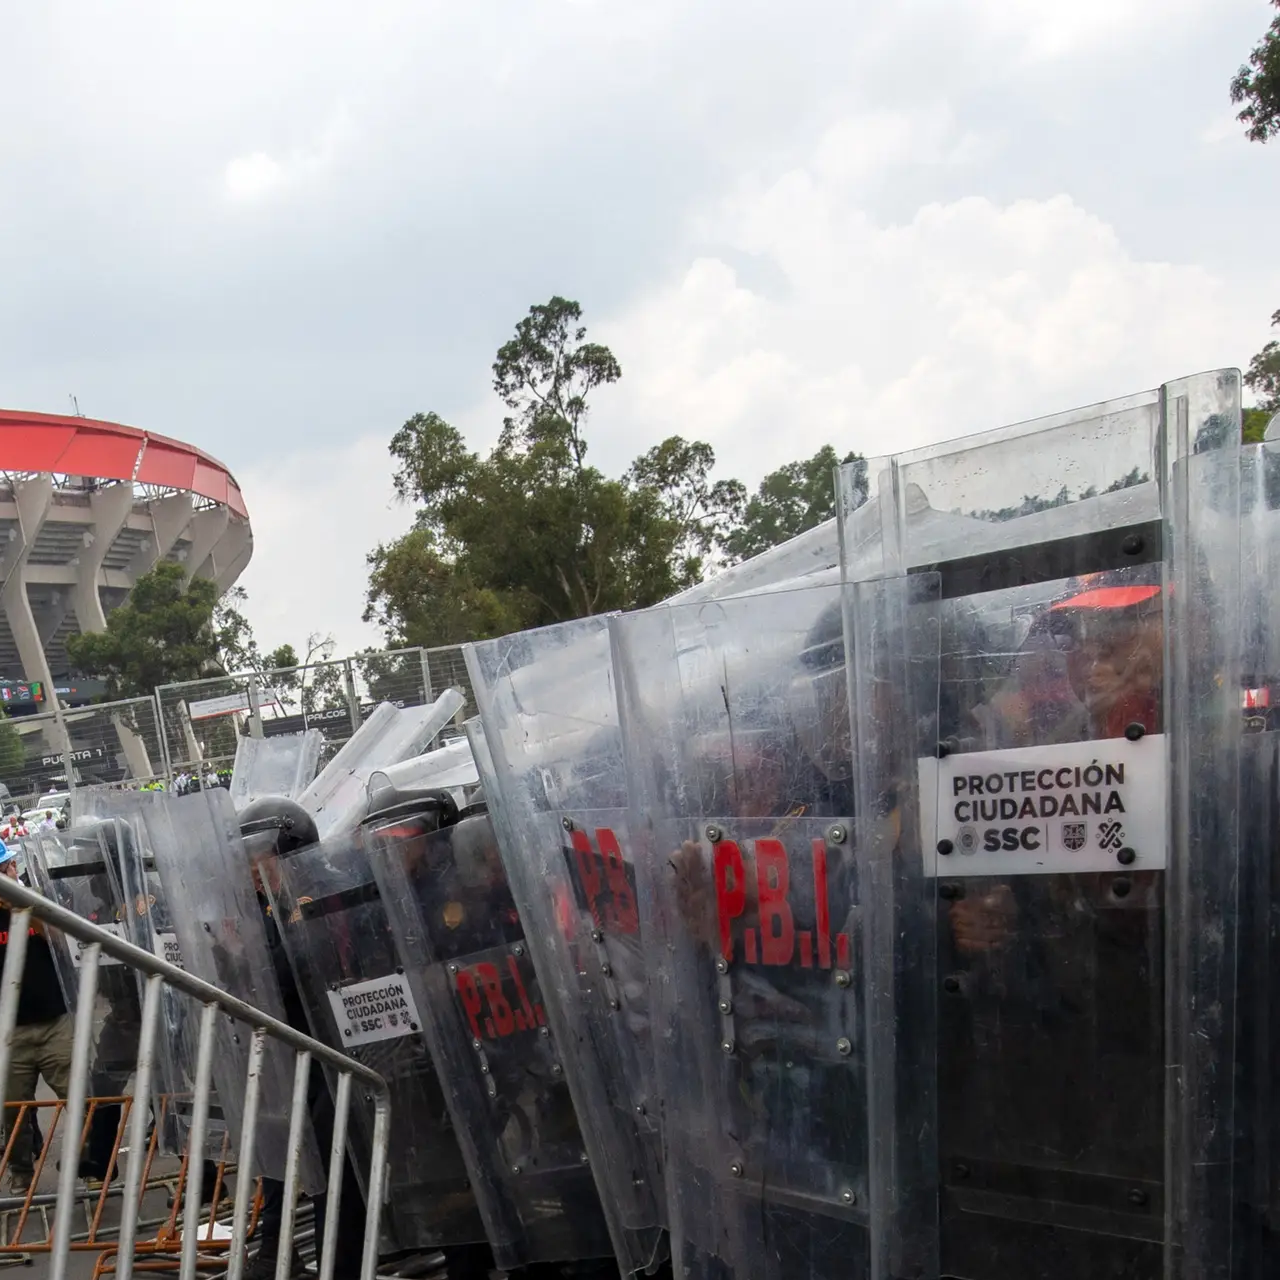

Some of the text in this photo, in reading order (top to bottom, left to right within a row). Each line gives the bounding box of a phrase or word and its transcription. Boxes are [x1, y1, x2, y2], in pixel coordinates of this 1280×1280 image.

[307, 709, 347, 722] PALCOS
[95, 748, 102, 757] 1
[952, 759, 1125, 796] PROTECCIÓN
[954, 791, 1125, 823] CIUDADANA
[983, 826, 1041, 852] SSC
[712, 838, 849, 969] P.B.I.
[342, 983, 404, 1008] PROTECCIÓN
[456, 954, 547, 1040] P.B.I.
[346, 997, 408, 1020] CIUDADANA
[361, 1017, 383, 1032] SSC
